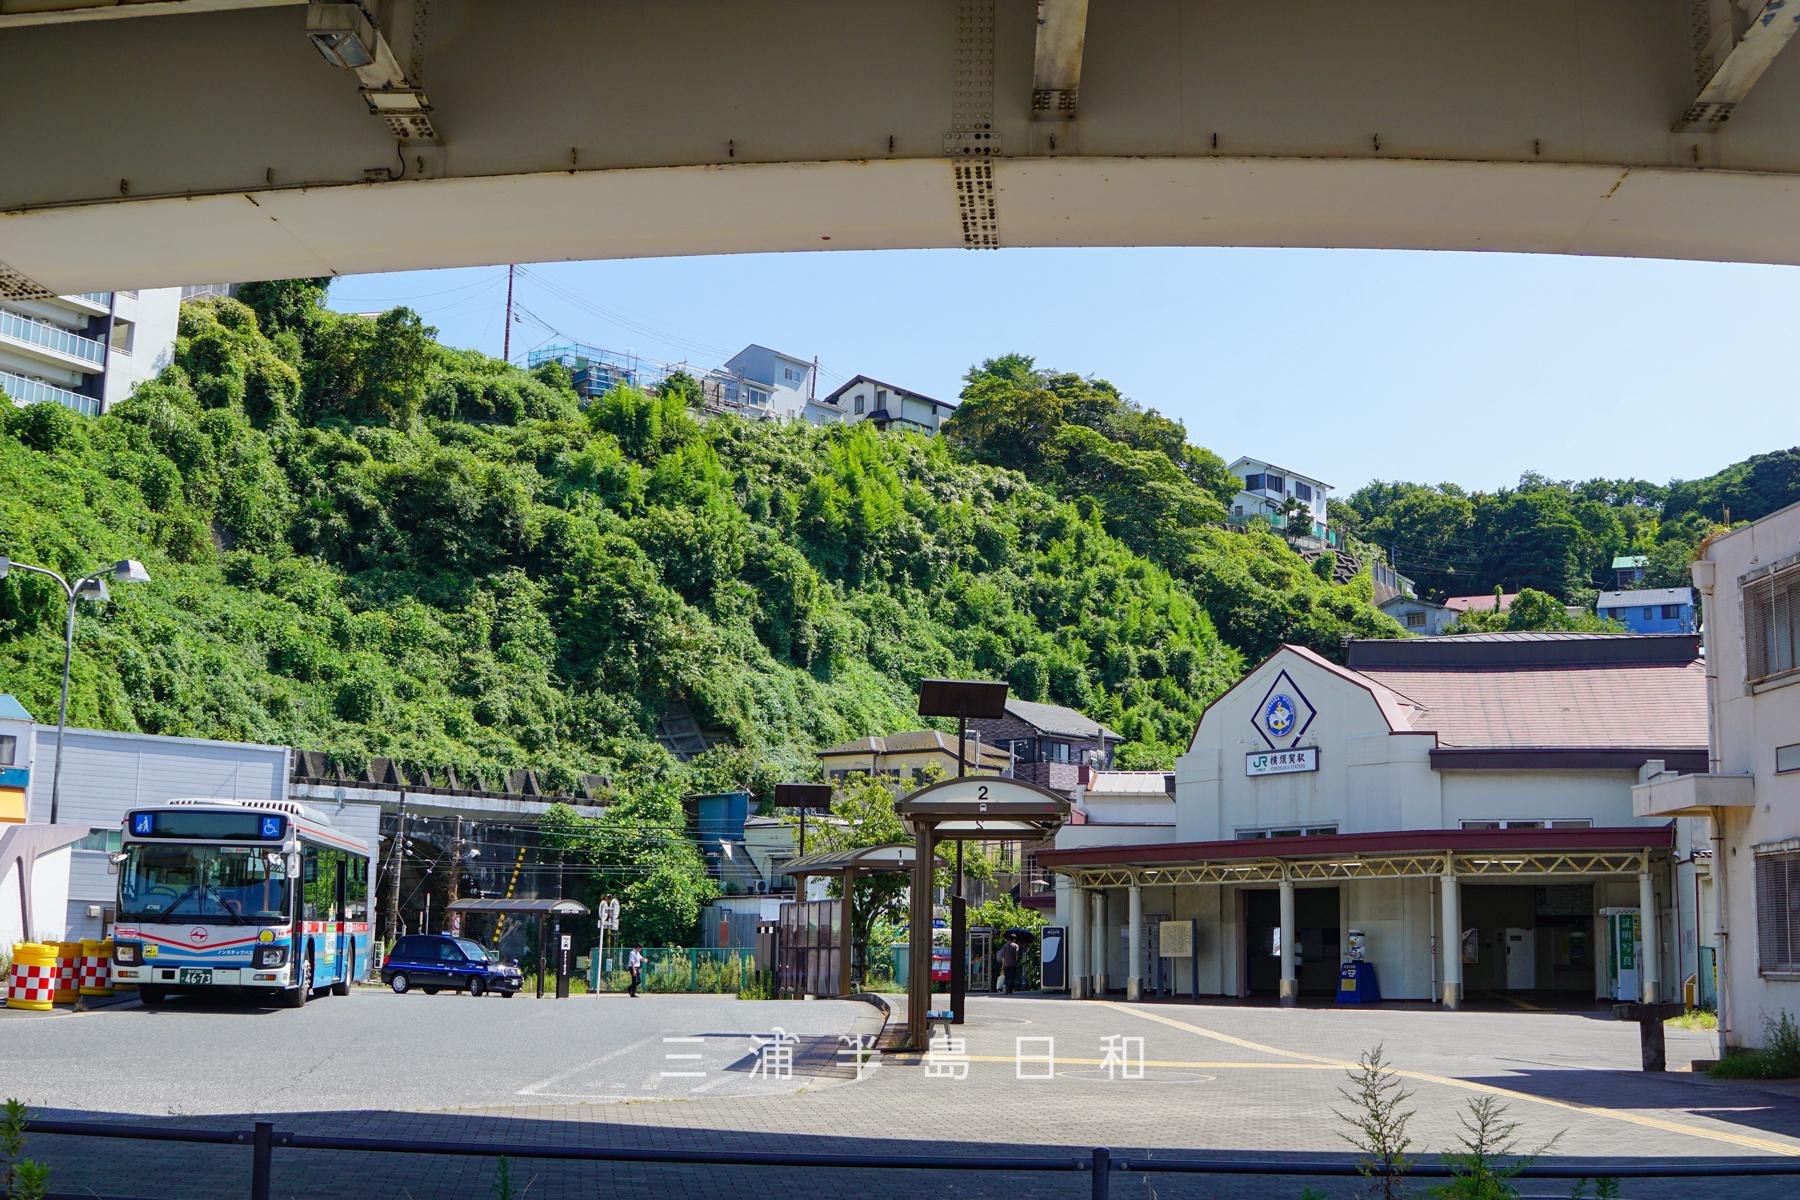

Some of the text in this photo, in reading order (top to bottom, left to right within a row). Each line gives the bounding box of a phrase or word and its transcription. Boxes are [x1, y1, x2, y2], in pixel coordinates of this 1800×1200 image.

[1253, 756, 1267, 768] JR
[1270, 753, 1305, 766] 横須賀駅
[978, 786, 988, 800] 2
[898, 850, 902, 858] 1
[1621, 918, 1632, 966] 証明写真
[185, 974, 211, 984] 46-73
